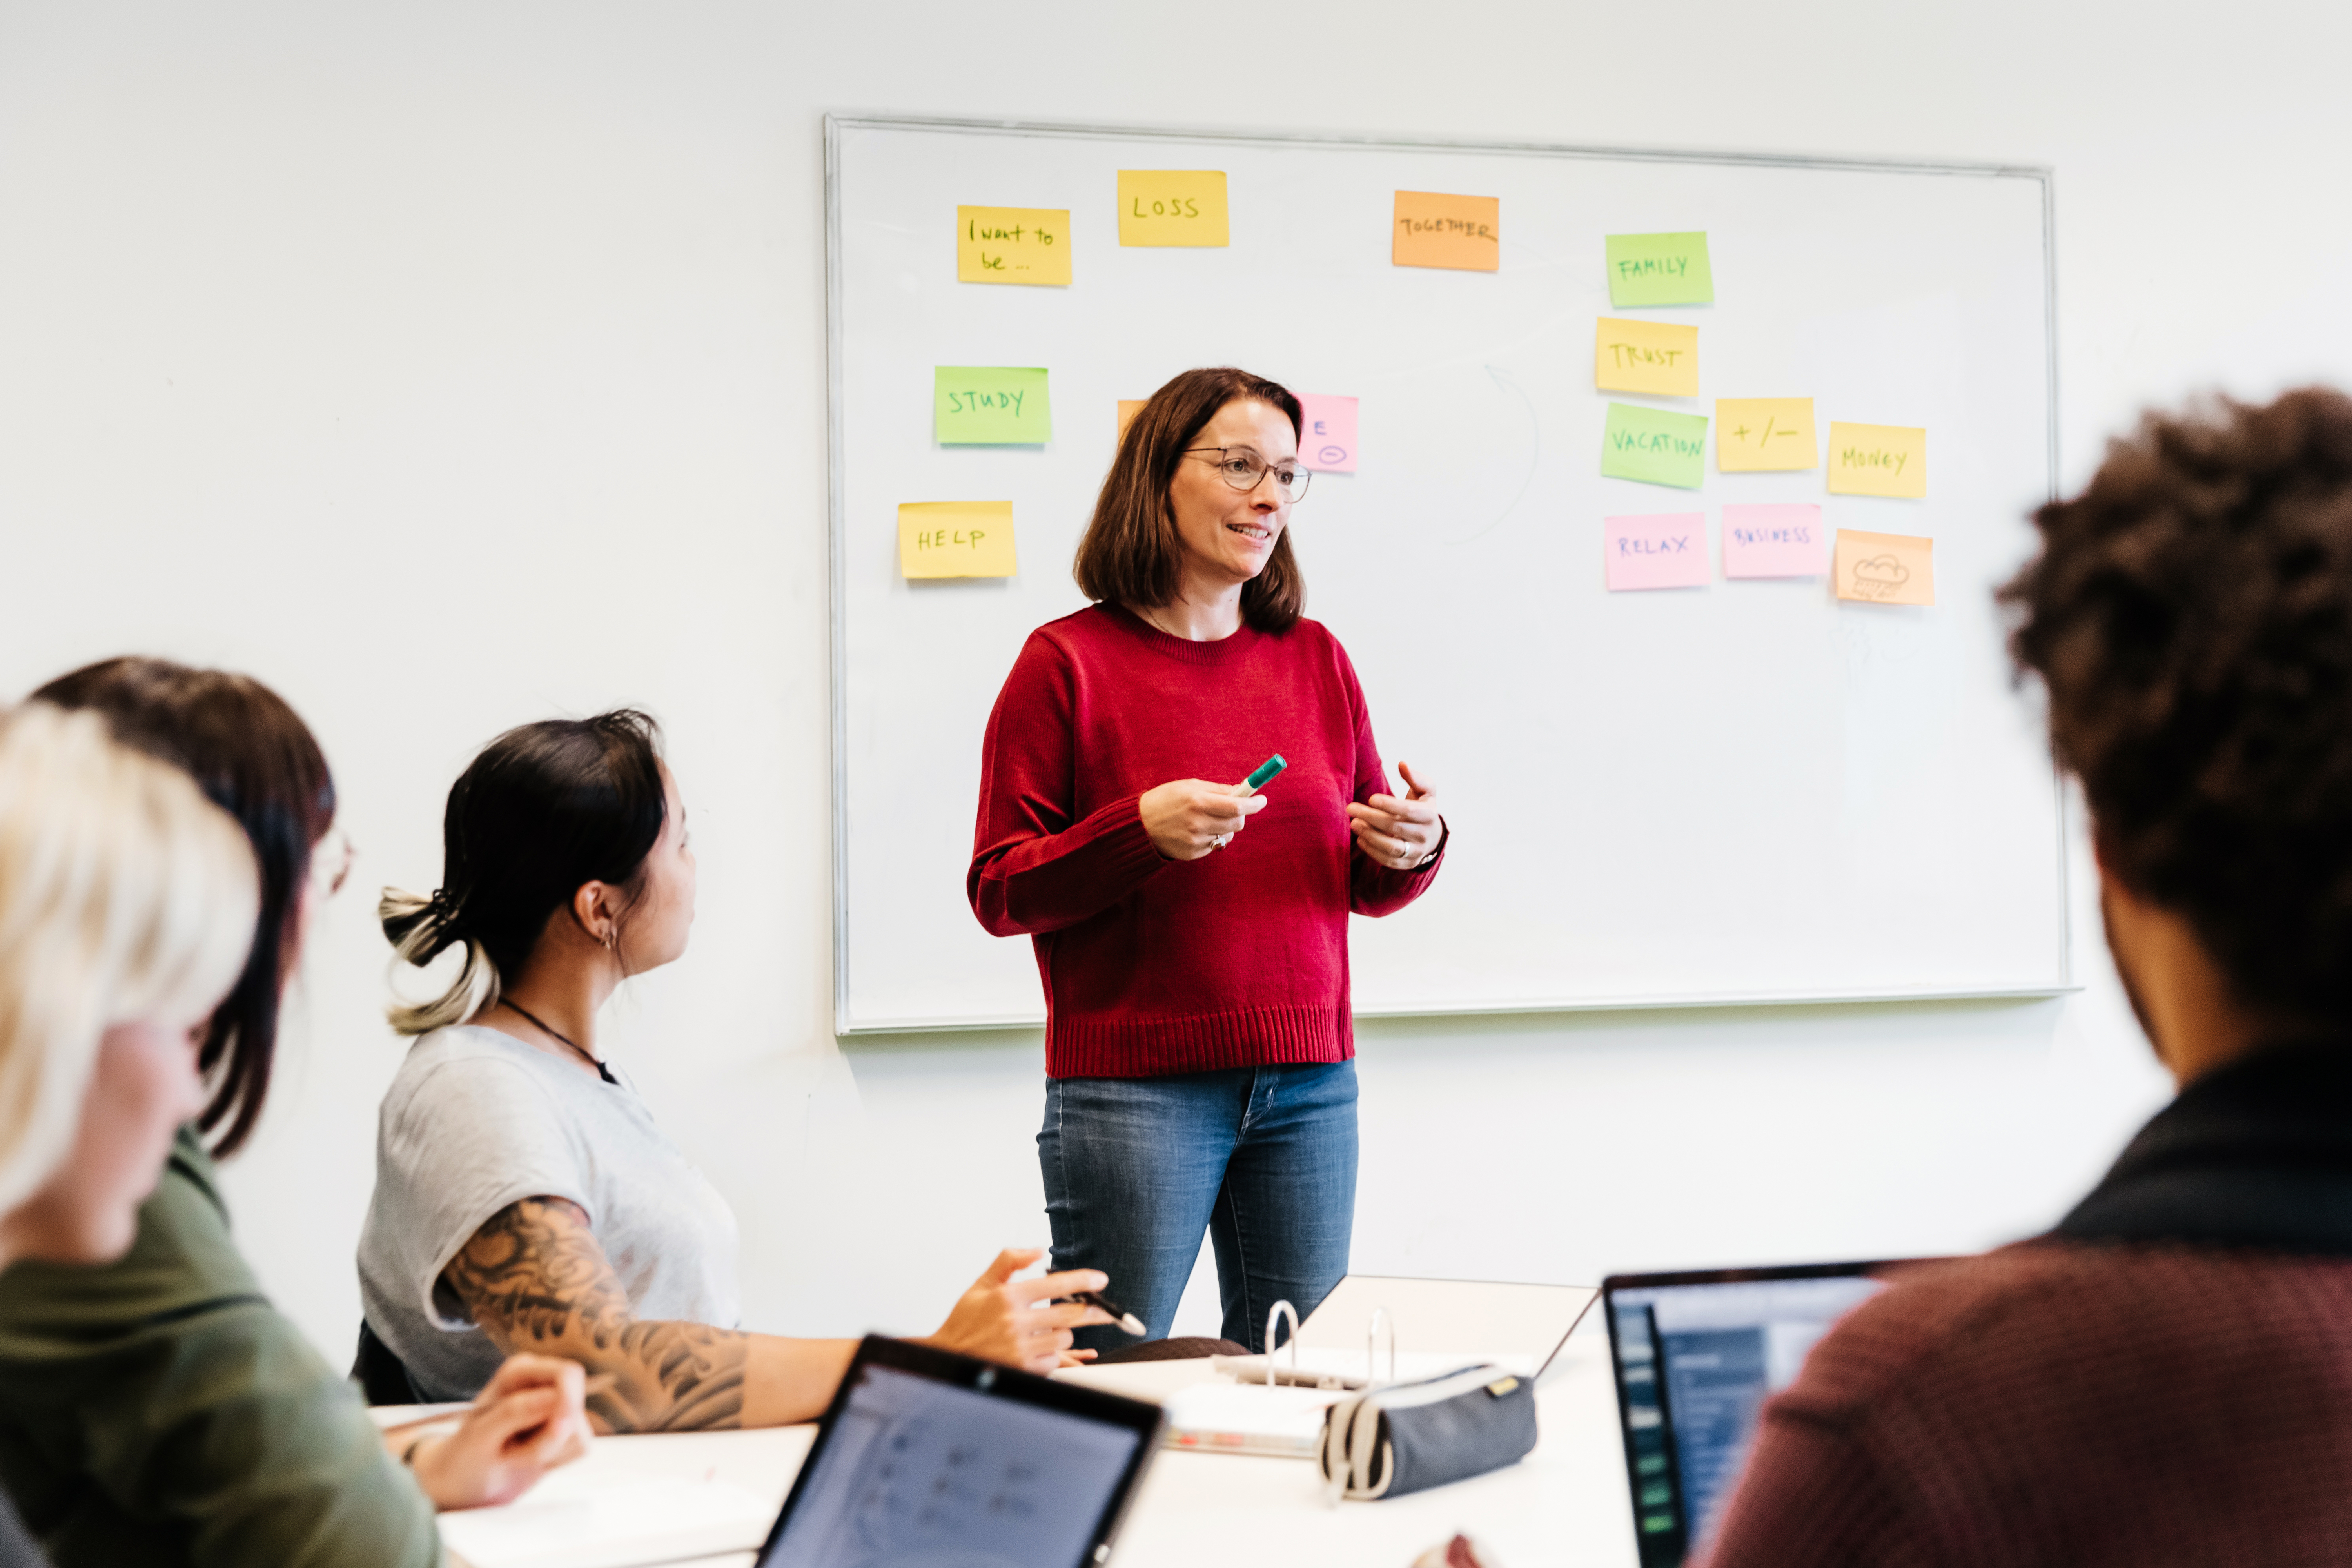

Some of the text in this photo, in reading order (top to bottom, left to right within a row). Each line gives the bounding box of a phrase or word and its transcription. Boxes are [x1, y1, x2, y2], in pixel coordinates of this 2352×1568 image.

[1133, 197, 1200, 218] LOSS
[969, 218, 1054, 245] I want to
[1401, 219, 1498, 242] TOGETHER
[1619, 256, 1688, 281] FAMILY
[1610, 343, 1683, 369] TRUST
[949, 390, 1024, 417] STUDY
[1612, 429, 1703, 457] VACATION
[1842, 447, 1907, 477] MONEY
[918, 530, 986, 550] HELP
[1618, 536, 1689, 558] RELAX
[1734, 527, 1811, 547] BUSINESS
